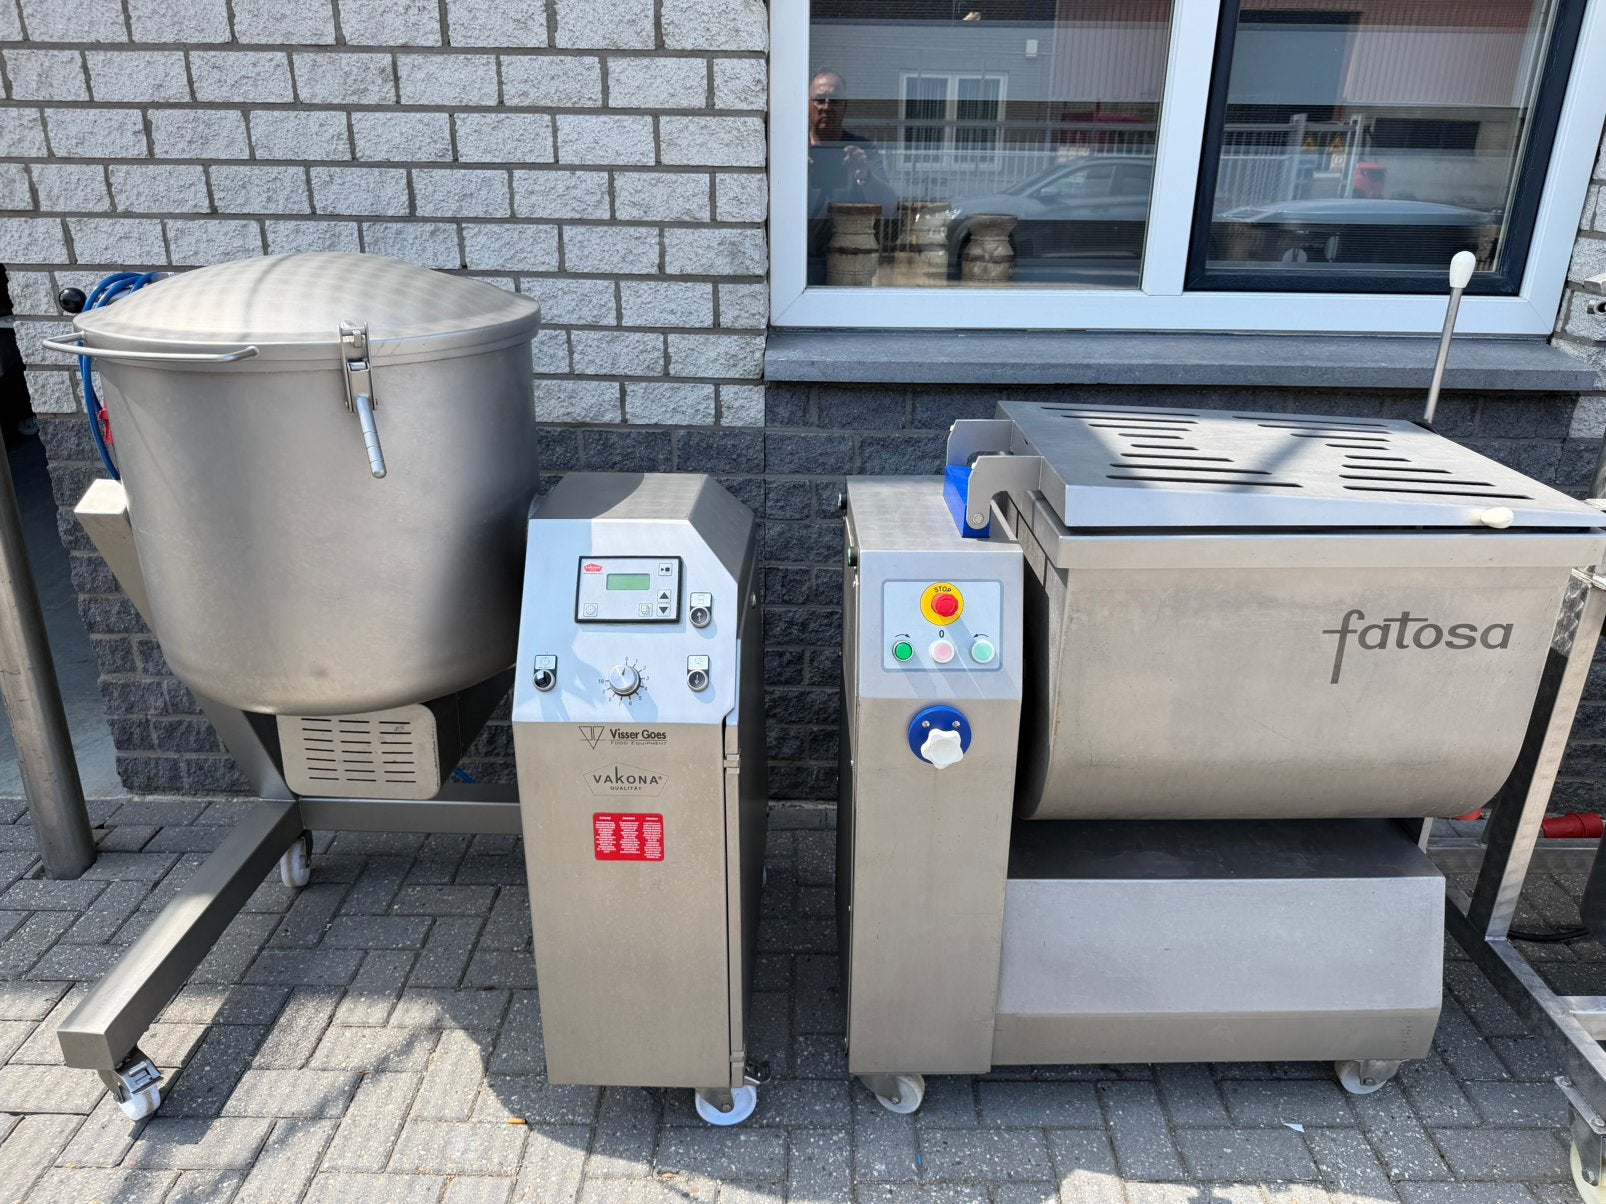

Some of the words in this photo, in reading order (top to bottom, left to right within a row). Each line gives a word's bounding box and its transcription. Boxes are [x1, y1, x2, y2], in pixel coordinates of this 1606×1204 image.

[934, 585, 952, 593] STOP
[938, 629, 945, 639] 0
[1322, 609, 1514, 685] fatosa
[610, 728, 640, 740] Visser
[641, 729, 667, 740] Goes
